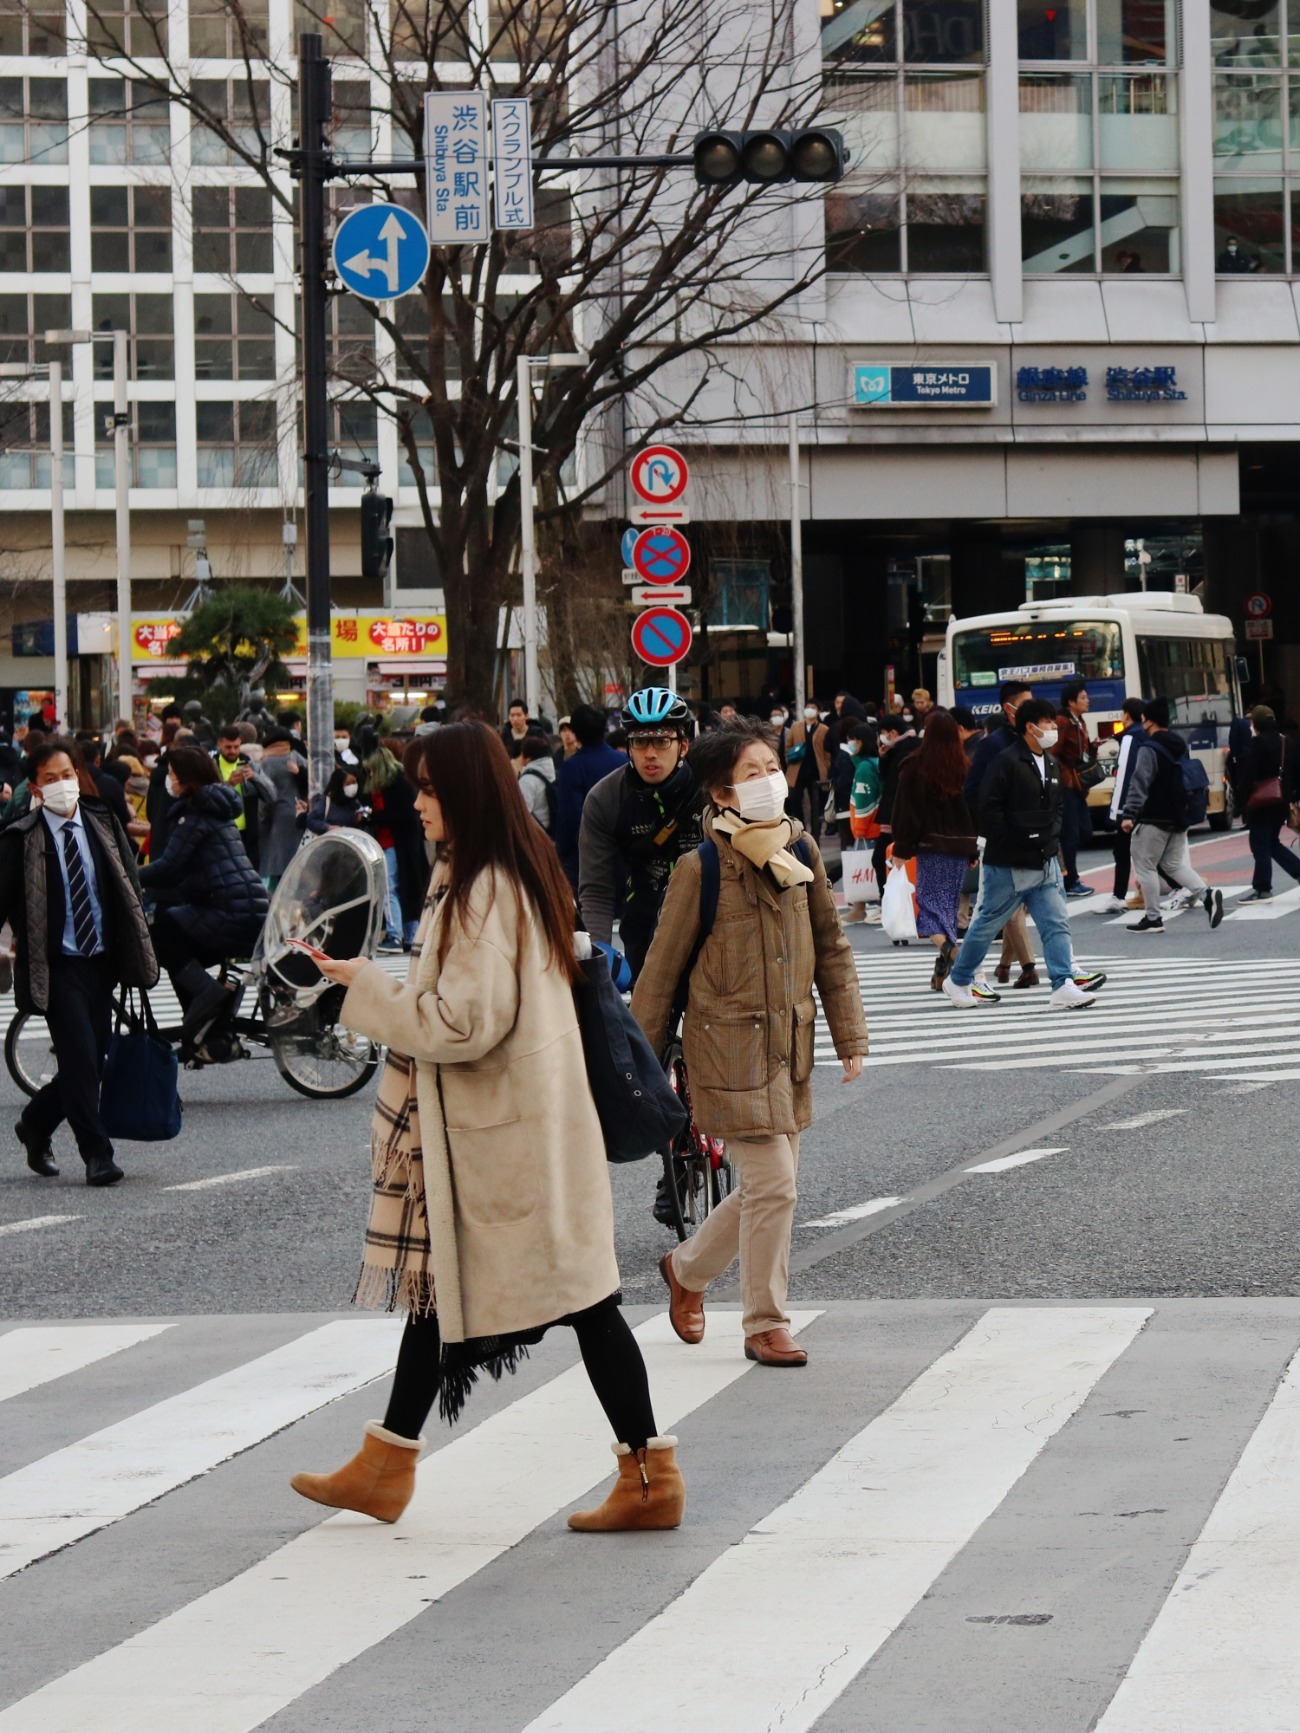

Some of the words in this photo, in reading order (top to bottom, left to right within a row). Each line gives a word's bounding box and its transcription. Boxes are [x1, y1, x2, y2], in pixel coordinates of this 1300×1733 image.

[433, 125, 449, 183] Shibuya
[452, 104, 481, 231] 渋谷駅前
[501, 105, 525, 224] スクランブル式
[436, 188, 450, 217] Sta.
[912, 373, 970, 385] 東京メトロ
[916, 386, 940, 396] Tokyo
[941, 386, 967, 395] Metro
[1018, 389, 1056, 402] Ginza
[1107, 388, 1160, 403] Shibuya
[371, 621, 438, 638] 大当たりの
[971, 703, 1002, 716] KEIO
[851, 867, 875, 885] H&M
